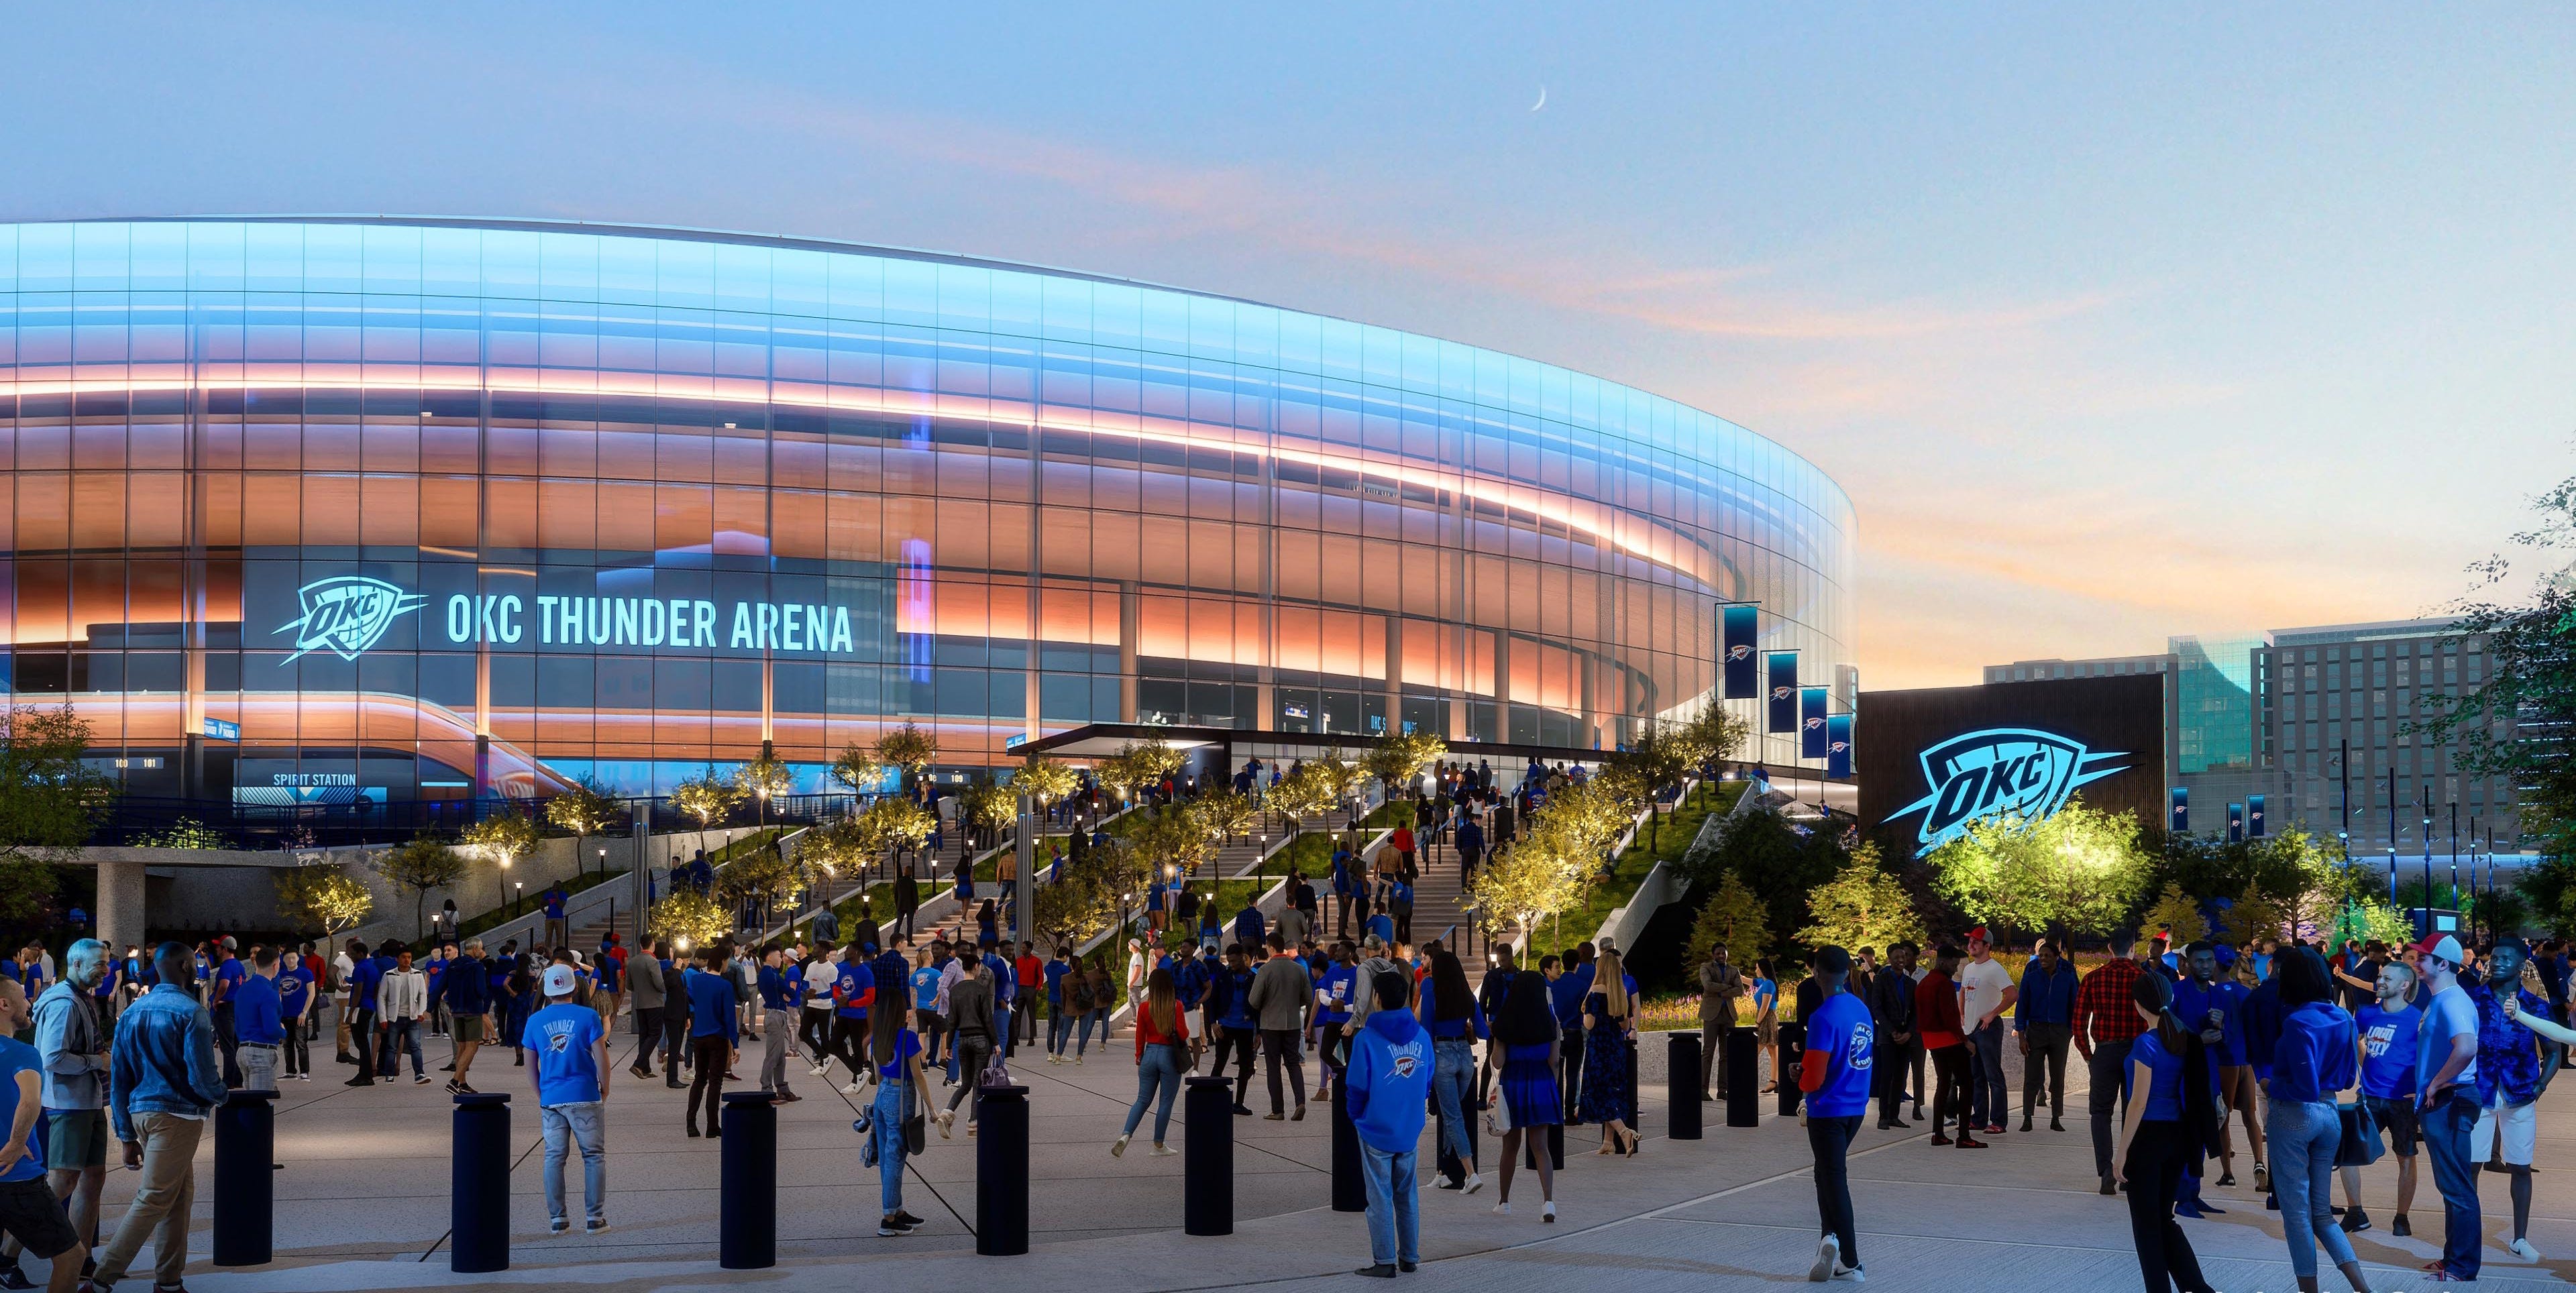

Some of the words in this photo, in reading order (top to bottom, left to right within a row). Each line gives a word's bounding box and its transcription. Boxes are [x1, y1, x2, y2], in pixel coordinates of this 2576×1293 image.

[302, 594, 378, 642] OKC
[448, 594, 522, 644] OKC
[537, 596, 717, 648] THUNDER
[730, 602, 853, 653] ARENA
[115, 758, 128, 768] 100
[144, 758, 156, 768] 101
[274, 774, 309, 785] SPIRIT
[313, 774, 356, 786] STATION
[951, 775, 963, 783] 109
[1927, 752, 2046, 834] OKC
[543, 1019, 575, 1037] THUNDER
[1387, 1041, 1422, 1059] THUNDER
[1395, 1060, 1414, 1076] OKC
